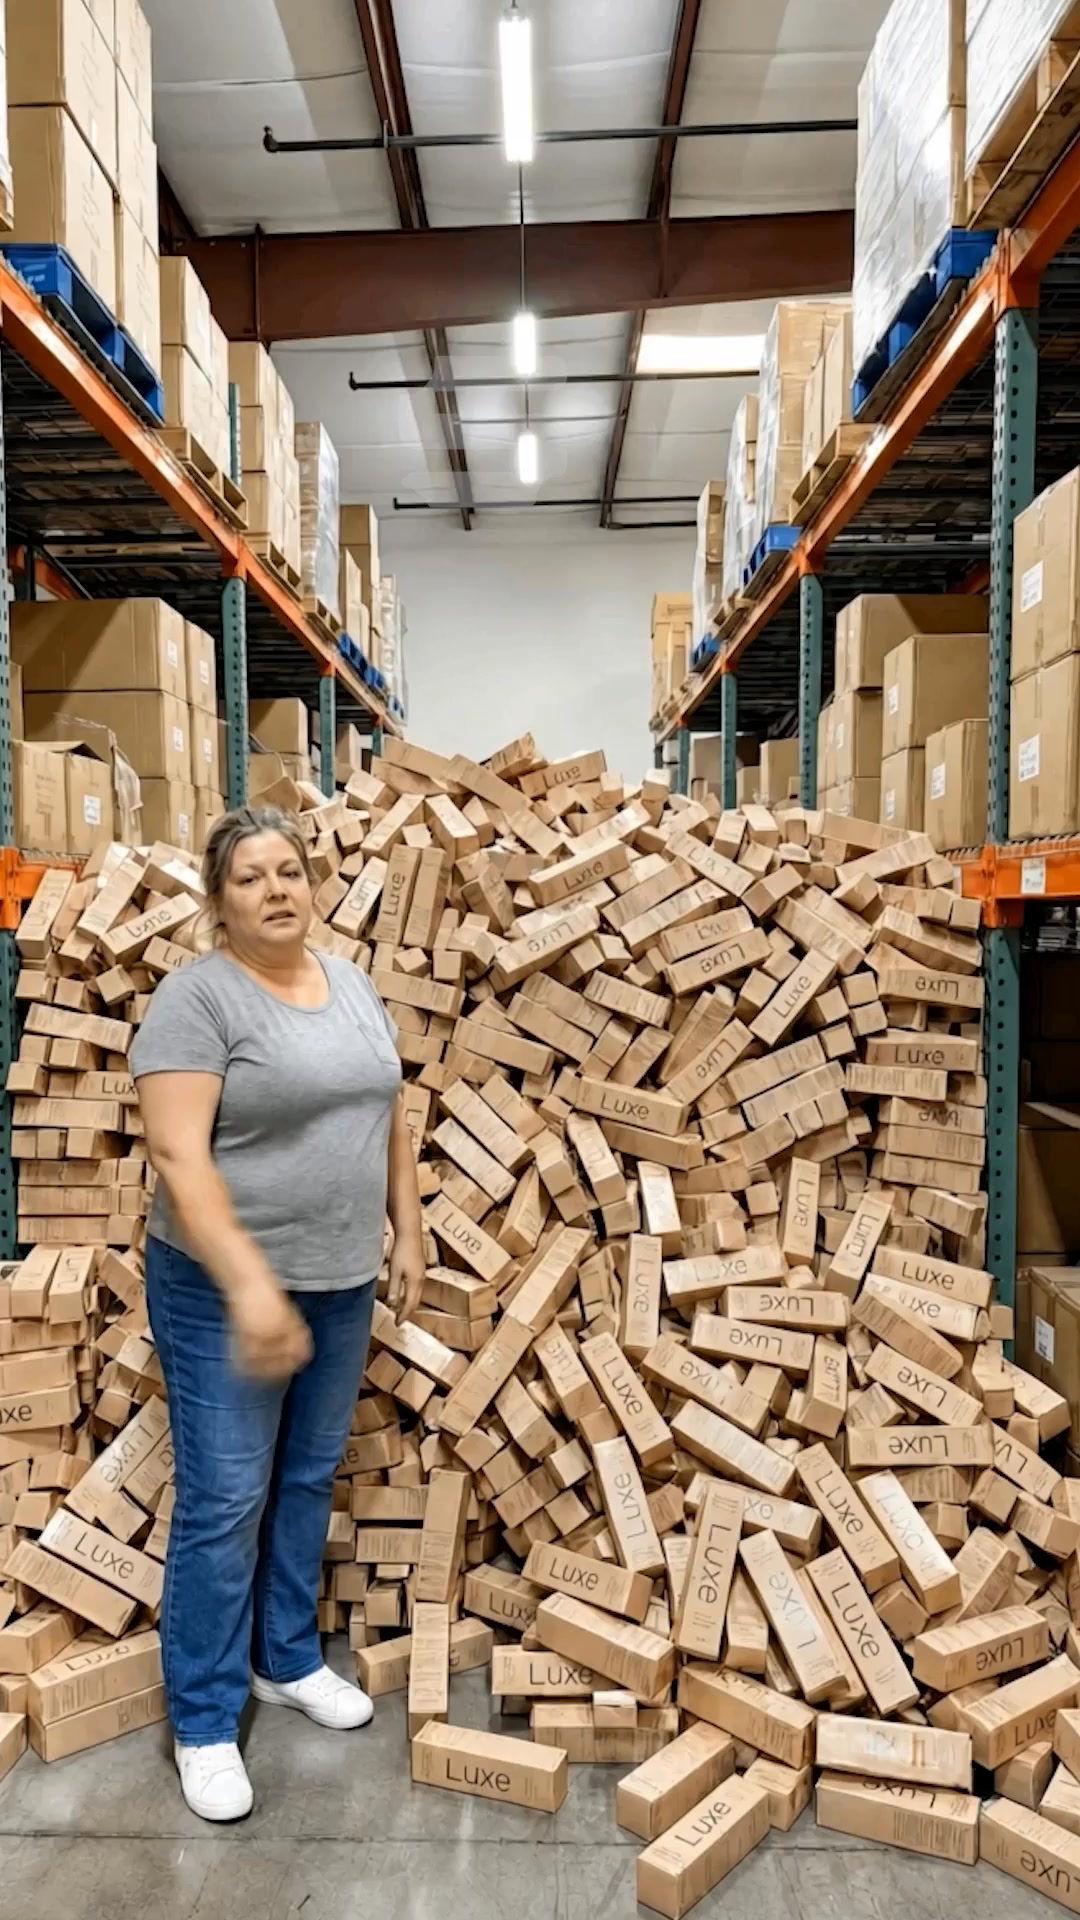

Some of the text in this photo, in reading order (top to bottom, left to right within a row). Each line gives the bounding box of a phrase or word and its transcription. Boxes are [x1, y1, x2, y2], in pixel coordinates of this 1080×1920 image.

[700, 943, 745, 974] Luxe
[695, 1038, 737, 1079] Luxe
[894, 1050, 945, 1065] Luxe
[102, 1077, 137, 1095] Lux
[601, 1092, 649, 1120] Luxe
[902, 1261, 955, 1291] Luxe
[729, 1328, 783, 1356] Luxe
[602, 1356, 643, 1416] Luxe
[889, 1435, 949, 1457] Luxe
[614, 1472, 648, 1540] Luxe
[815, 1470, 864, 1535] Luxe
[74, 1532, 134, 1579] Luxe
[698, 1524, 732, 1604] Luxe
[549, 1557, 600, 1591] Luxe
[831, 1581, 880, 1658] Luxe
[976, 1636, 1025, 1671] Luxe
[529, 1662, 594, 1686] Luxe
[446, 1757, 512, 1792] Luxe
[675, 1801, 731, 1847] Luxe
[1020, 1849, 1080, 1893] uxe
